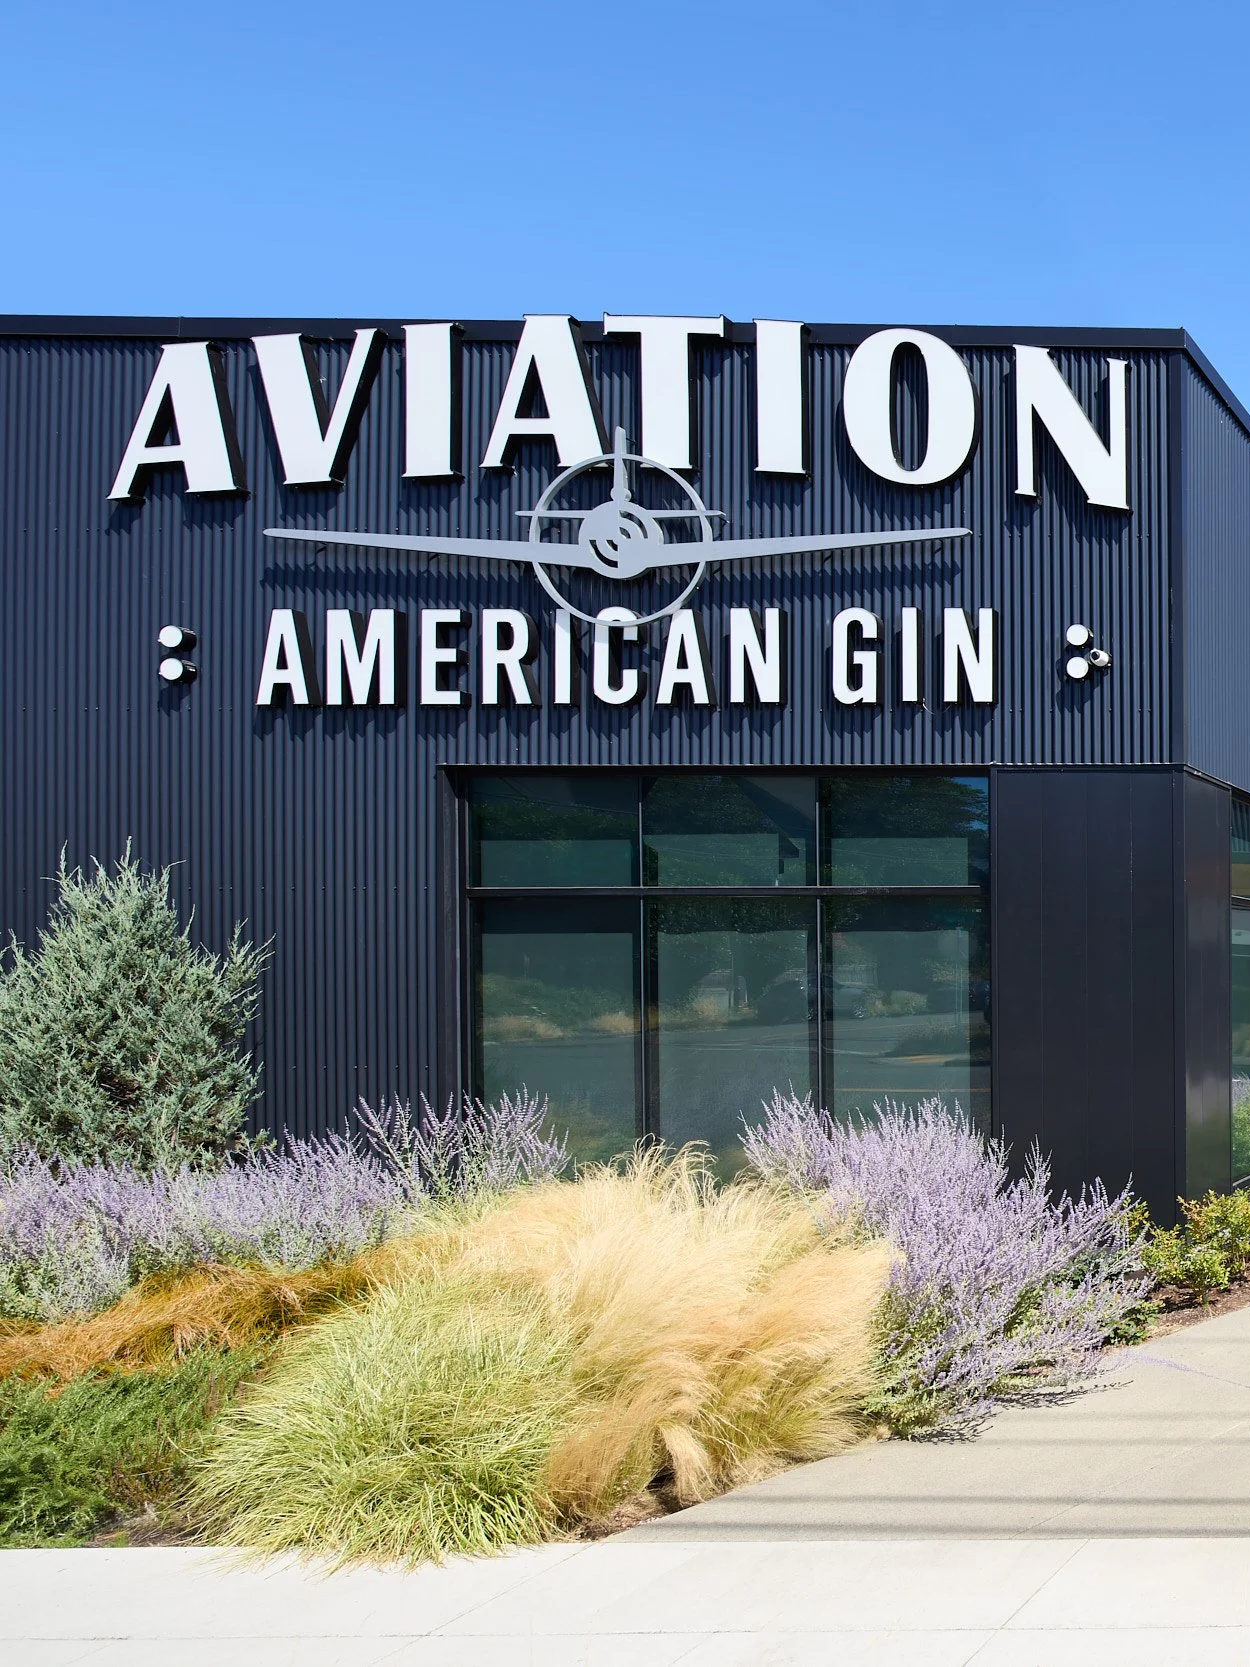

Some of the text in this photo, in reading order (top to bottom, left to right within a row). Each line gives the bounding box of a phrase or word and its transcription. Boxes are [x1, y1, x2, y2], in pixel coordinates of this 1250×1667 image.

[107, 313, 1129, 510] AVIATION
[256, 606, 994, 705] AMERICAN GIN
